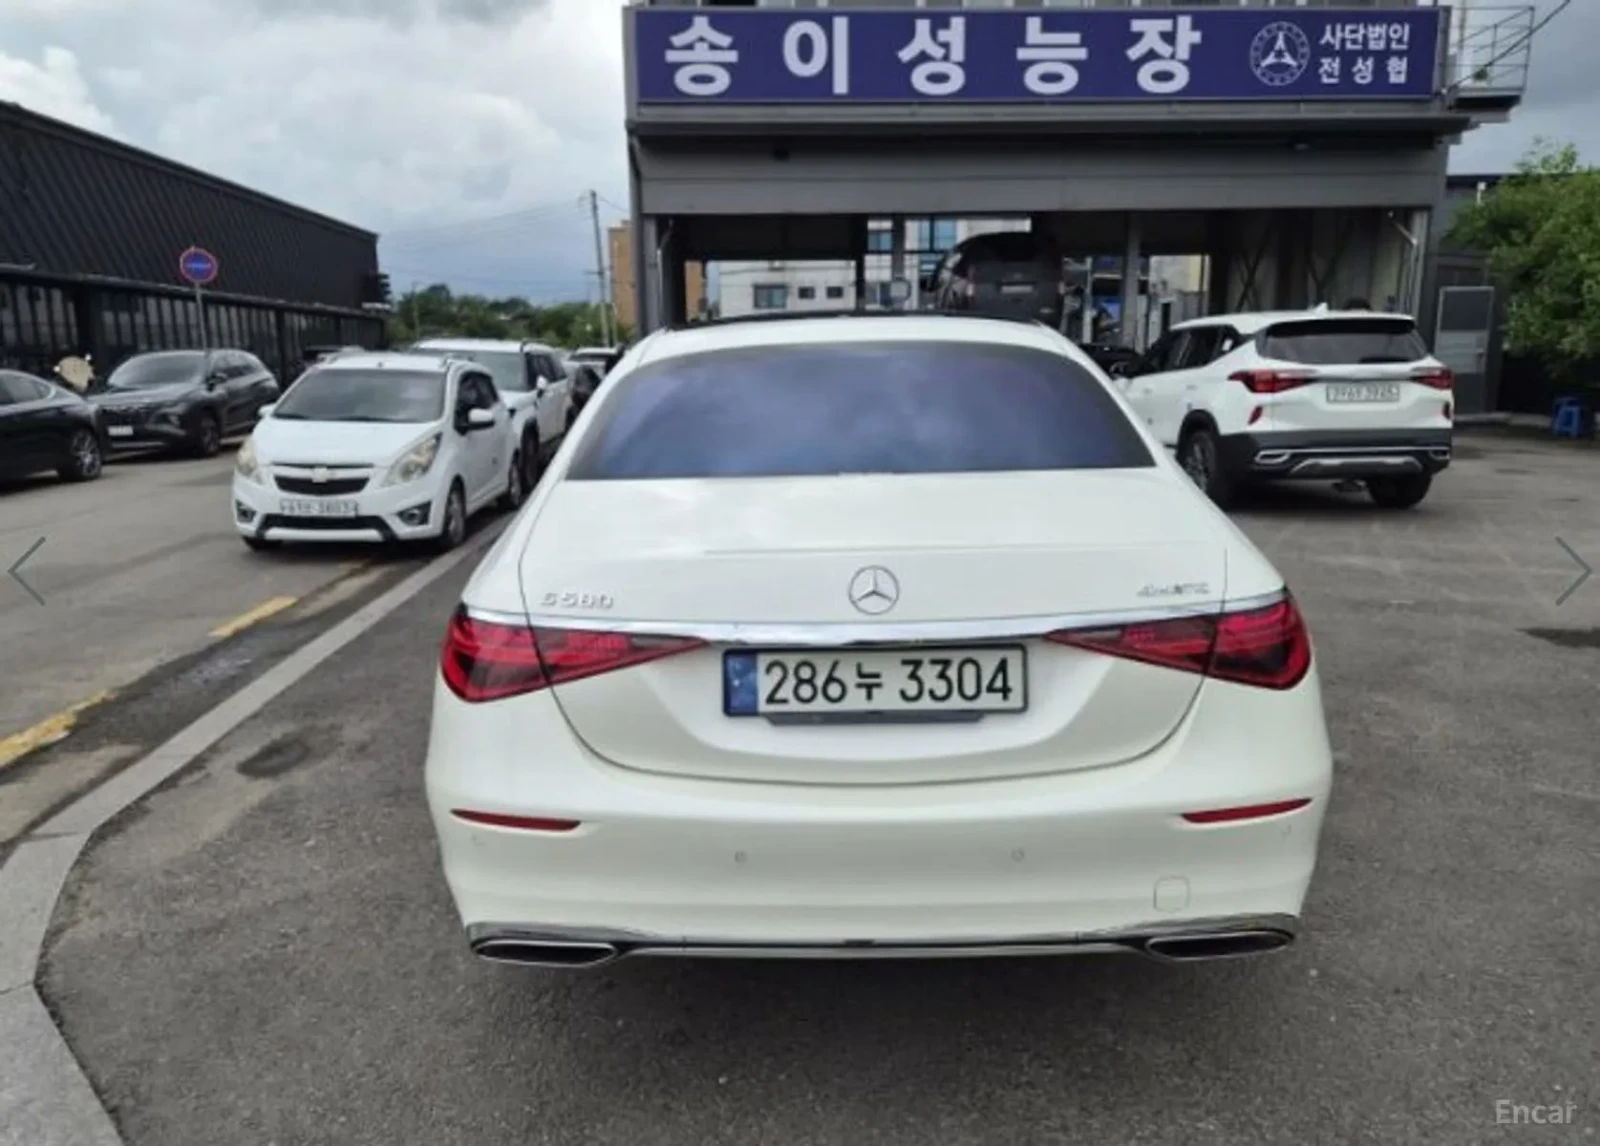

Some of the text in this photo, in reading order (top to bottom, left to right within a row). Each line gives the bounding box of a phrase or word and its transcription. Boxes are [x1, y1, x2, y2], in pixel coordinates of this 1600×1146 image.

[1319, 22, 1410, 51] 사단법인
[765, 656, 1013, 705] 286누 3304
